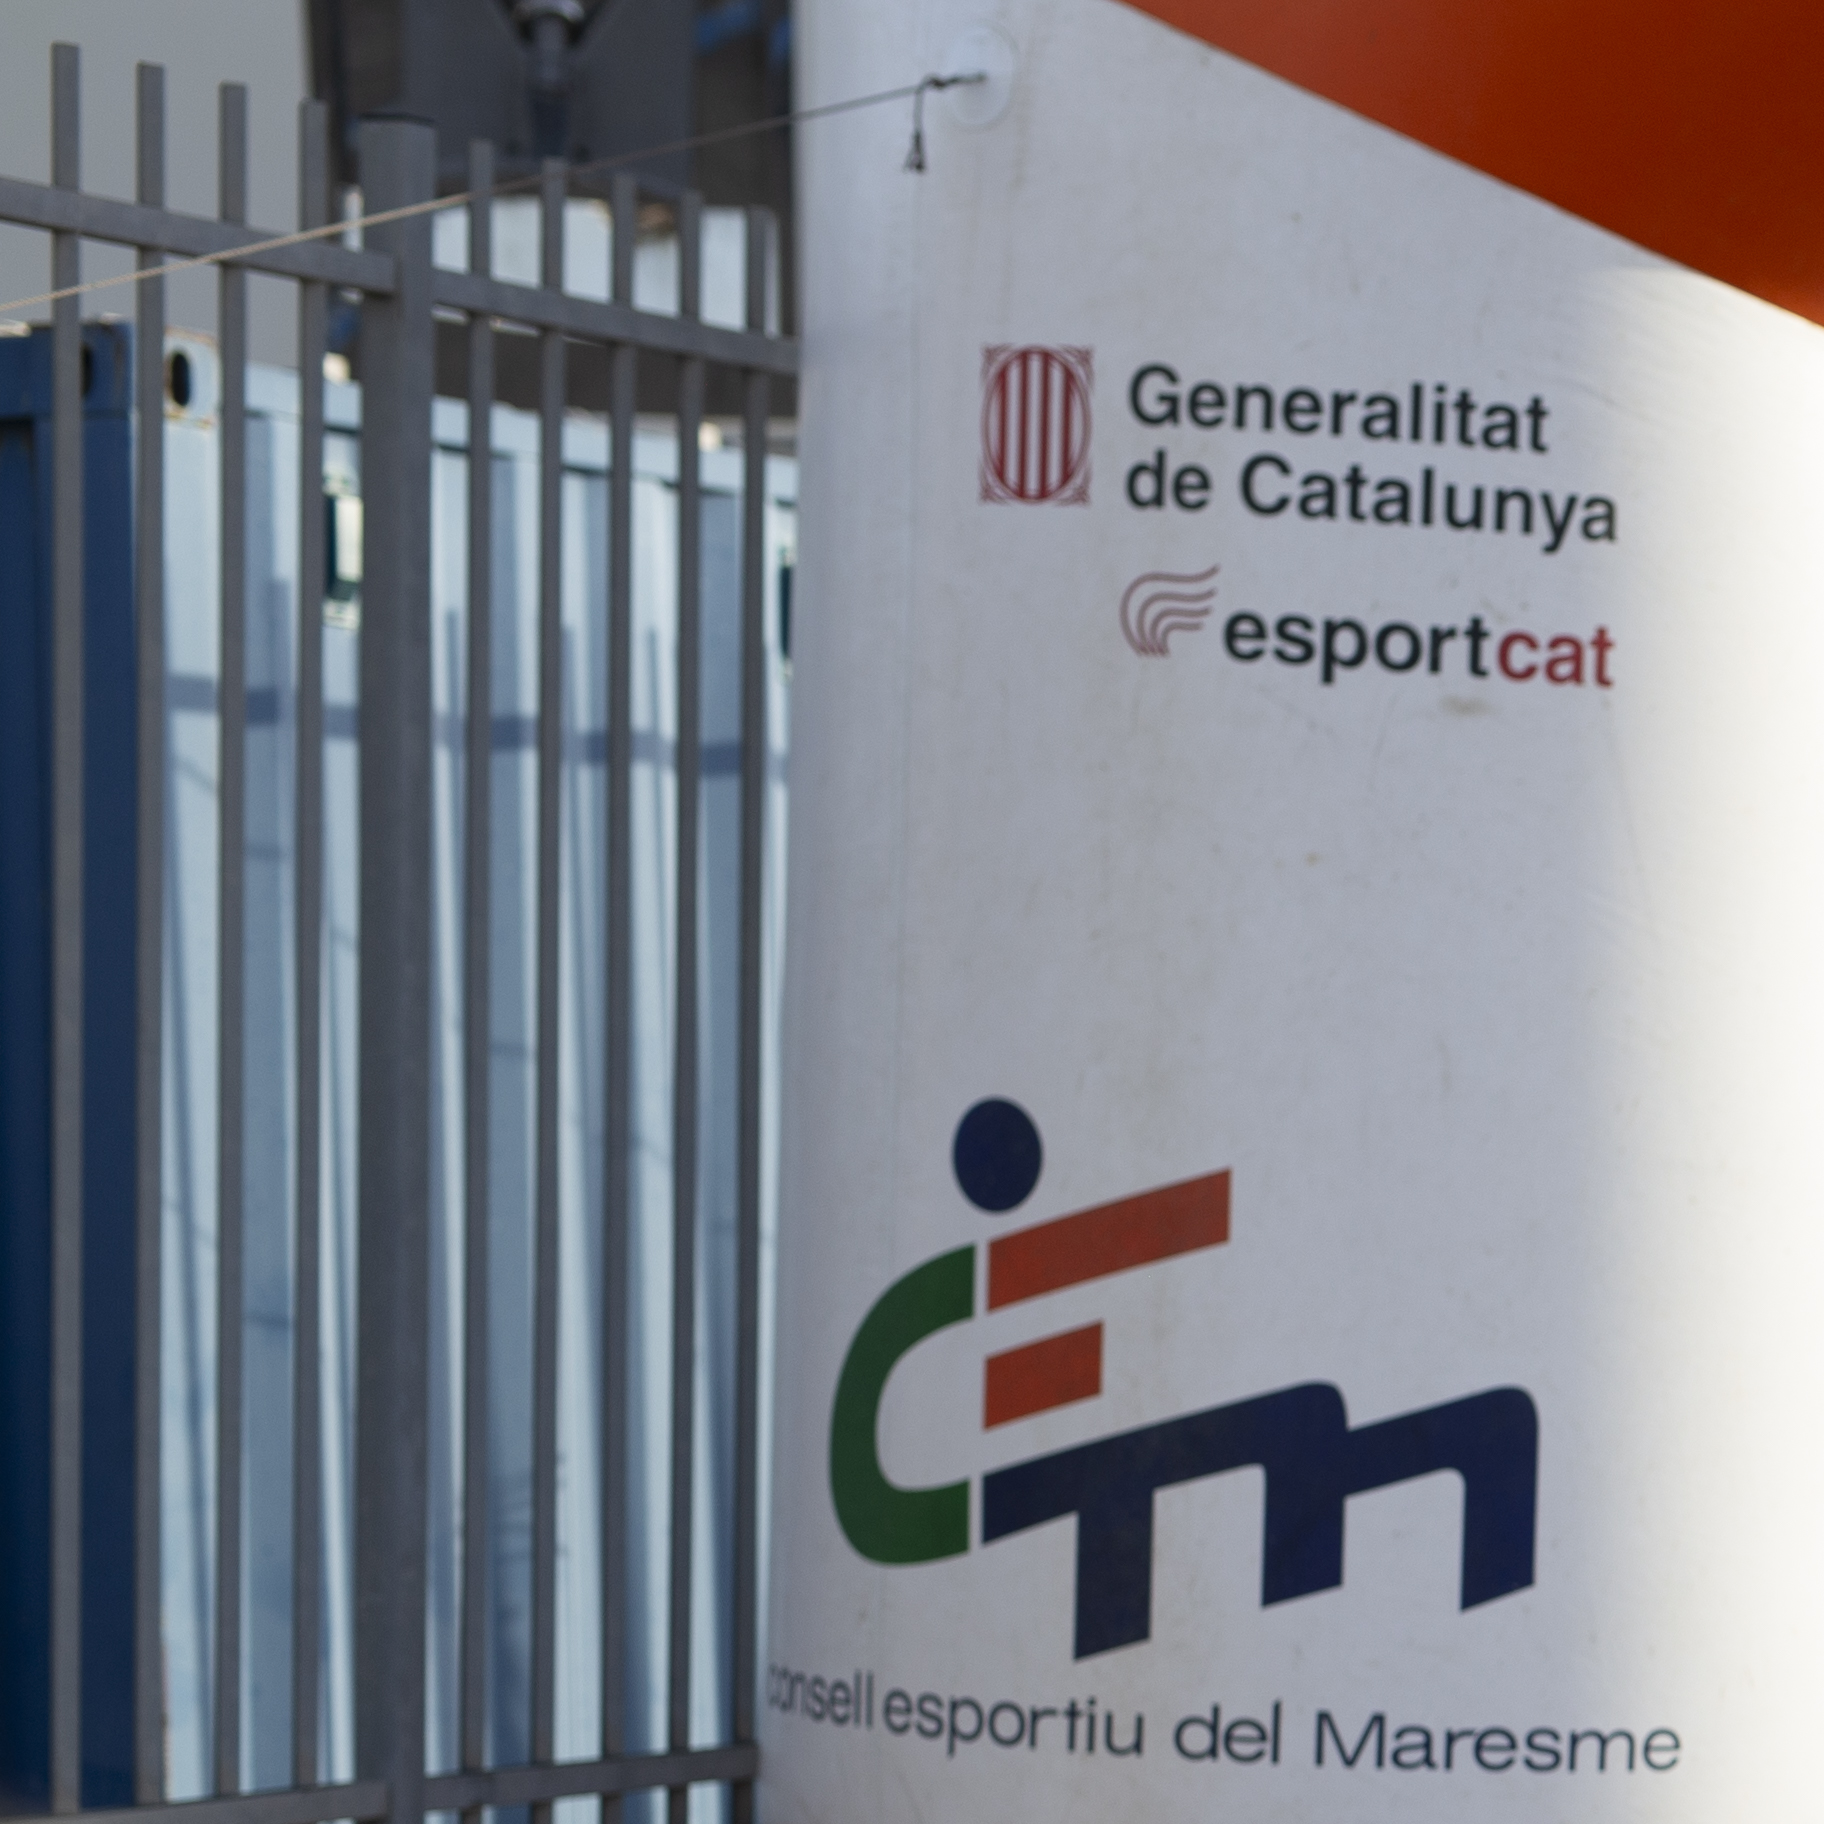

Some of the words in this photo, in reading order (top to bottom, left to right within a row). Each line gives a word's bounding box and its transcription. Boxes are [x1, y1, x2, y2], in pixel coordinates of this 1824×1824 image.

[1127, 364, 1550, 454] Generalitat
[1125, 448, 1212, 511] de
[1239, 455, 1619, 553] Catalunya
[1222, 608, 1615, 686] esportcat
[882, 1692, 1146, 1759] esportiu
[1174, 1700, 1281, 1766] del
[1313, 1710, 1682, 1774] Maresme
